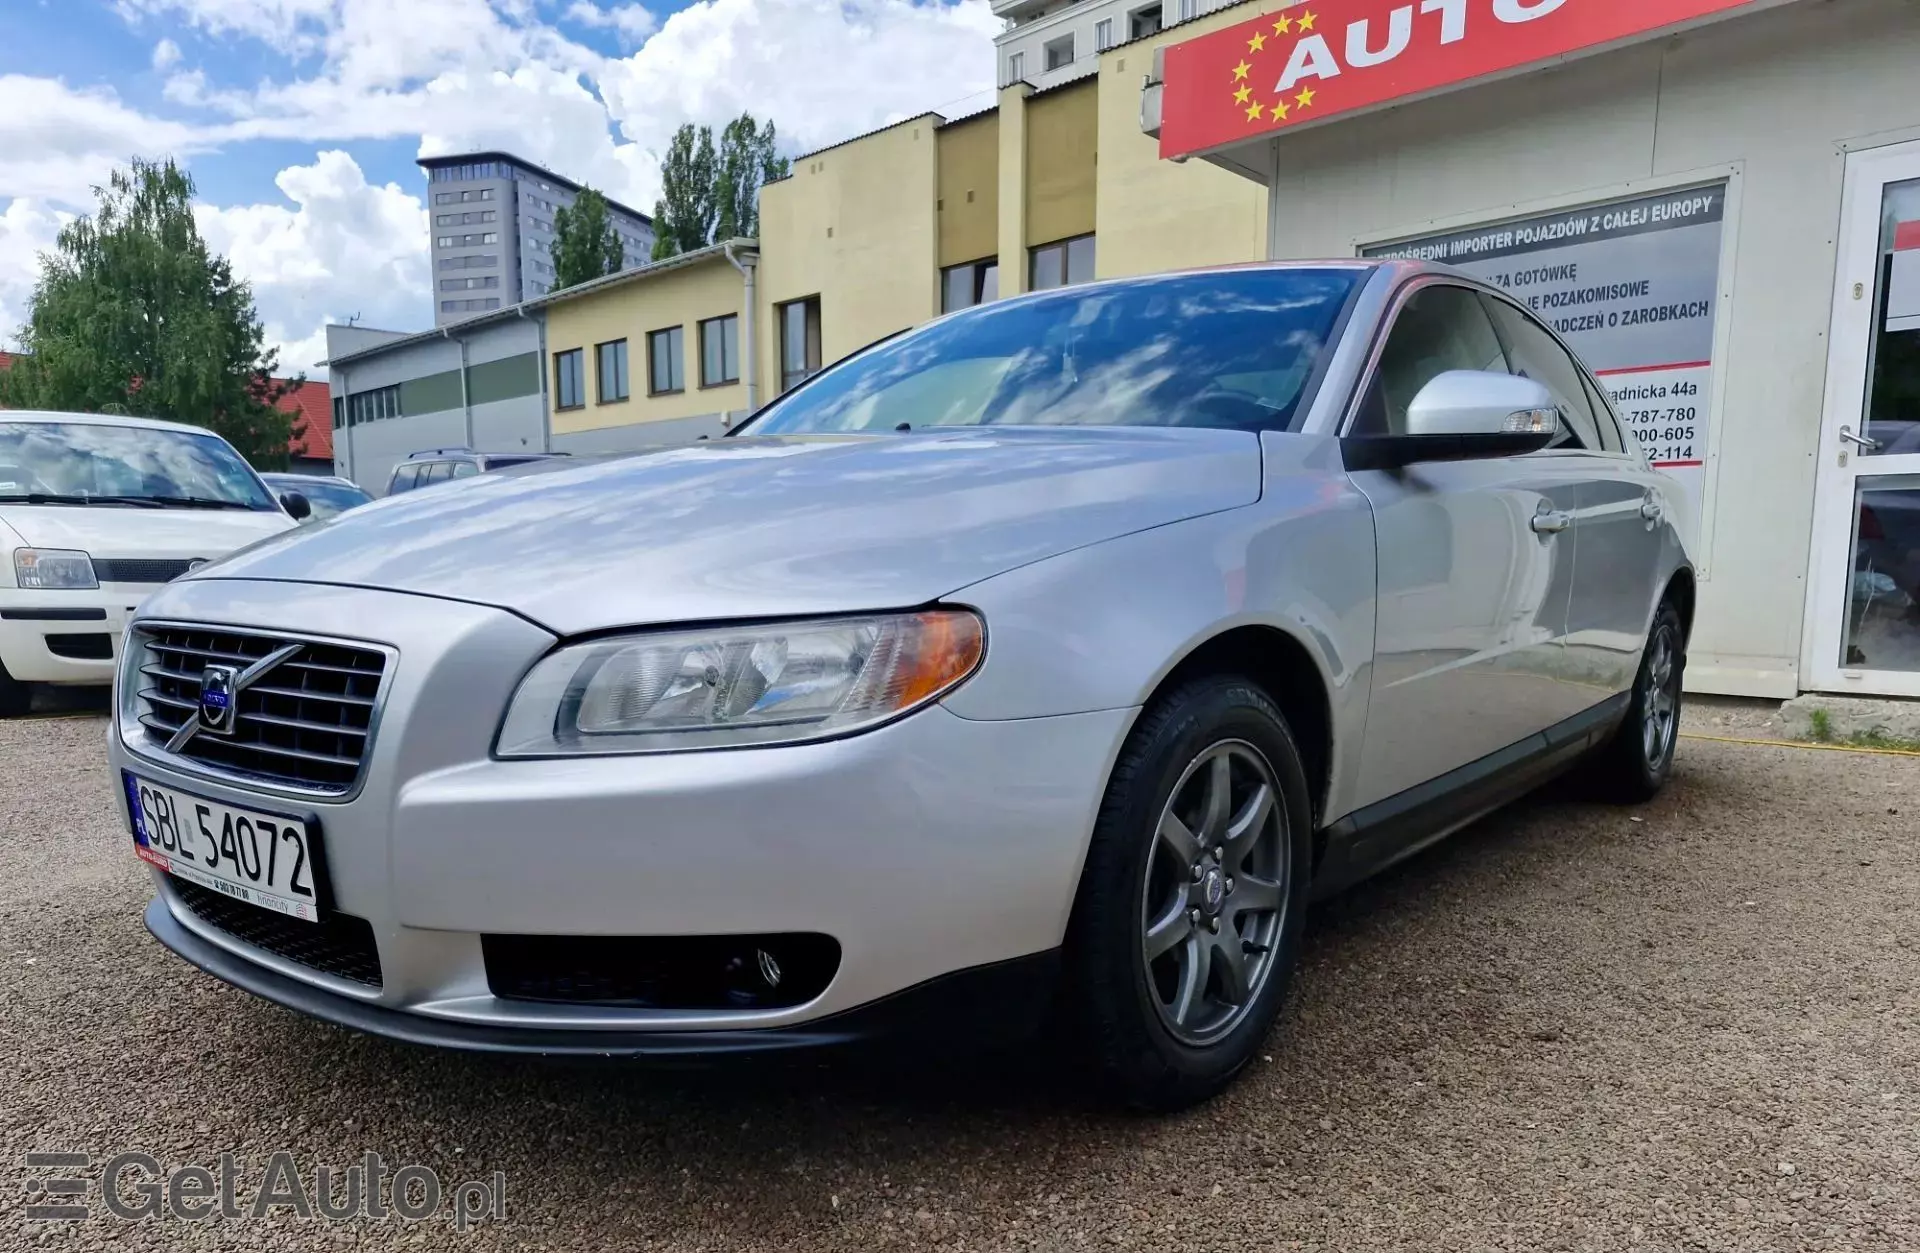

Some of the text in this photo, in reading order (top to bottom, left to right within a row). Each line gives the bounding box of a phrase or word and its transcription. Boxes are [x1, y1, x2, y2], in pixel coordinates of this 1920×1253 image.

[1450, 230, 1513, 257] IMPORTER
[1515, 217, 1588, 246] POJAZDÓW
[1590, 216, 1599, 232] Z
[1603, 207, 1648, 231] CAŁEJ
[1651, 196, 1712, 222] EUROPY
[1514, 263, 1577, 287] GOTÓWKĘ
[1543, 280, 1649, 309] POZAKOMISOWE
[1608, 312, 1618, 328] O
[1621, 300, 1709, 326] ZAROBKACH
[1671, 381, 1697, 397] 44a
[1621, 407, 1696, 424] -787-780
[136, 817, 147, 835] PL
[141, 785, 313, 898] SBL 54072
